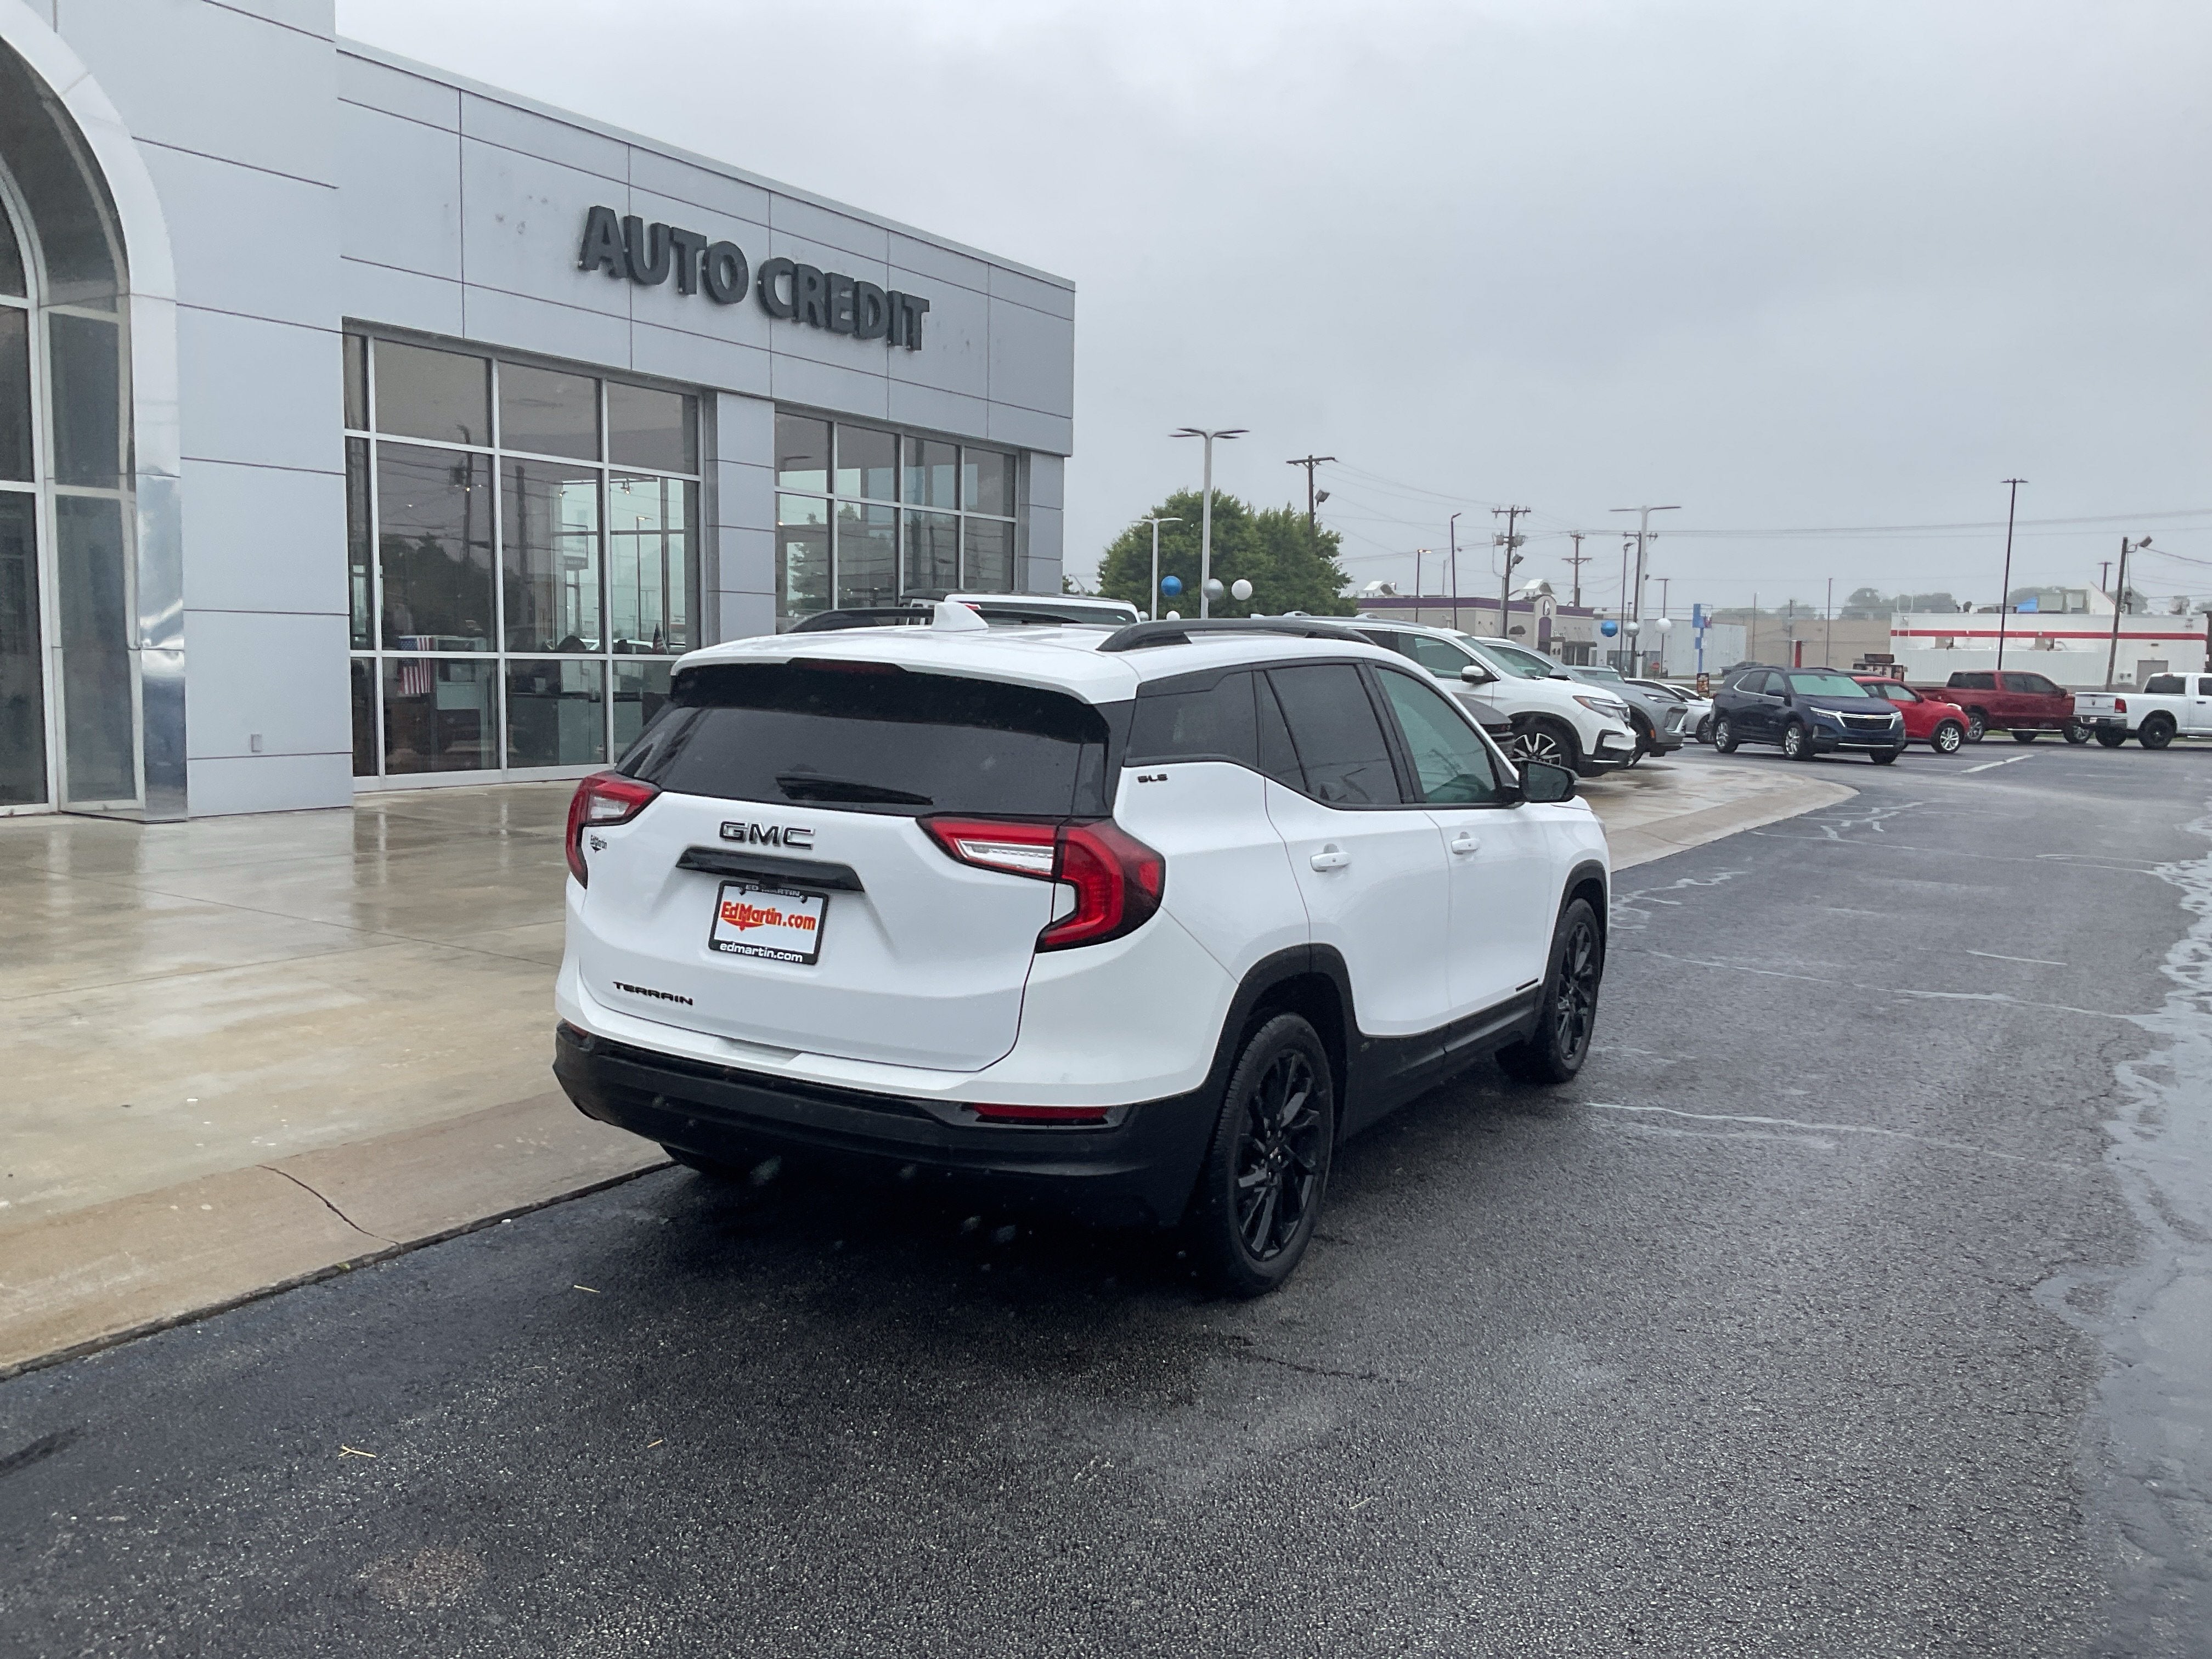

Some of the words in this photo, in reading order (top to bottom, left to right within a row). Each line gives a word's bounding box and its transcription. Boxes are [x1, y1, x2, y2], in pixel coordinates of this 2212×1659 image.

[578, 205, 749, 304] AUTO
[757, 257, 930, 351] CREDIT
[719, 821, 815, 850] GMC
[720, 942, 803, 962] edmartin.com
[612, 981, 693, 1006] TERRAIN
